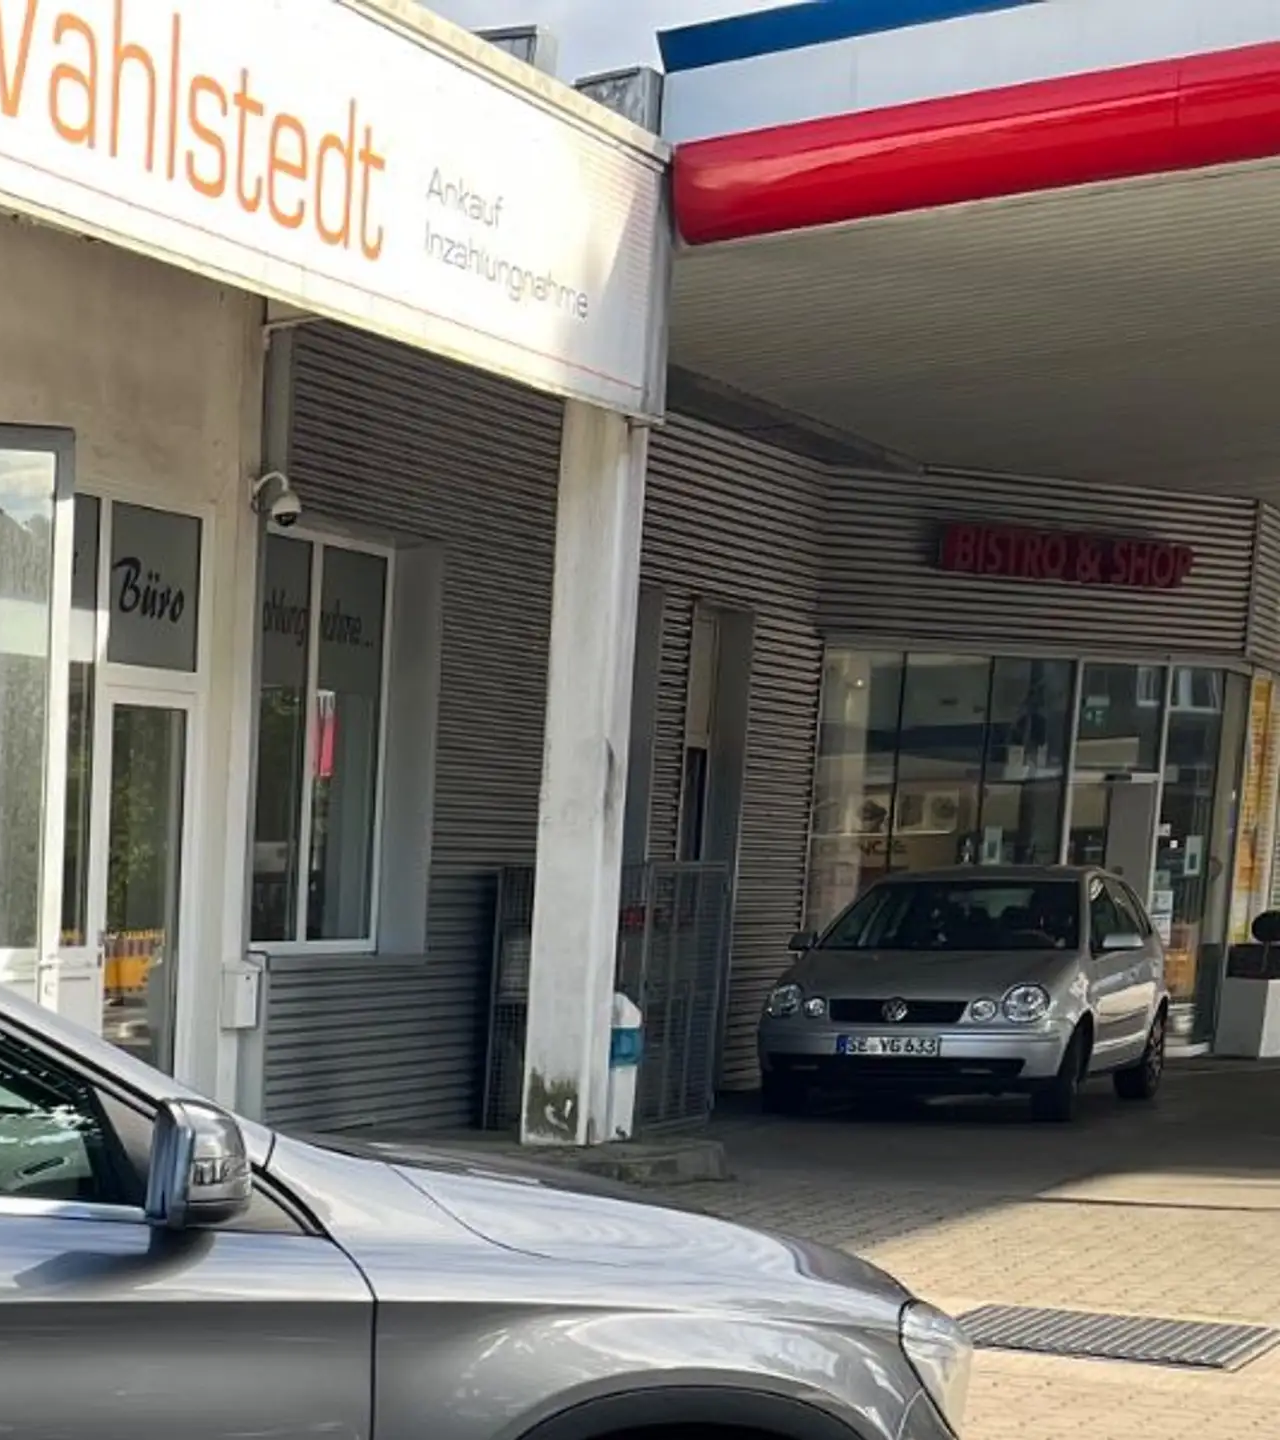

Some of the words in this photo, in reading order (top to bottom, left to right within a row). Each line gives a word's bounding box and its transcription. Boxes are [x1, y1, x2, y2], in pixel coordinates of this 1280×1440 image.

[426, 167, 504, 229] Ankauf
[425, 220, 589, 319] Inzahlungnahme
[953, 525, 1068, 580] BISTRO
[1075, 533, 1102, 584] &
[1111, 538, 1193, 588] SHOP
[111, 556, 185, 623] Büro
